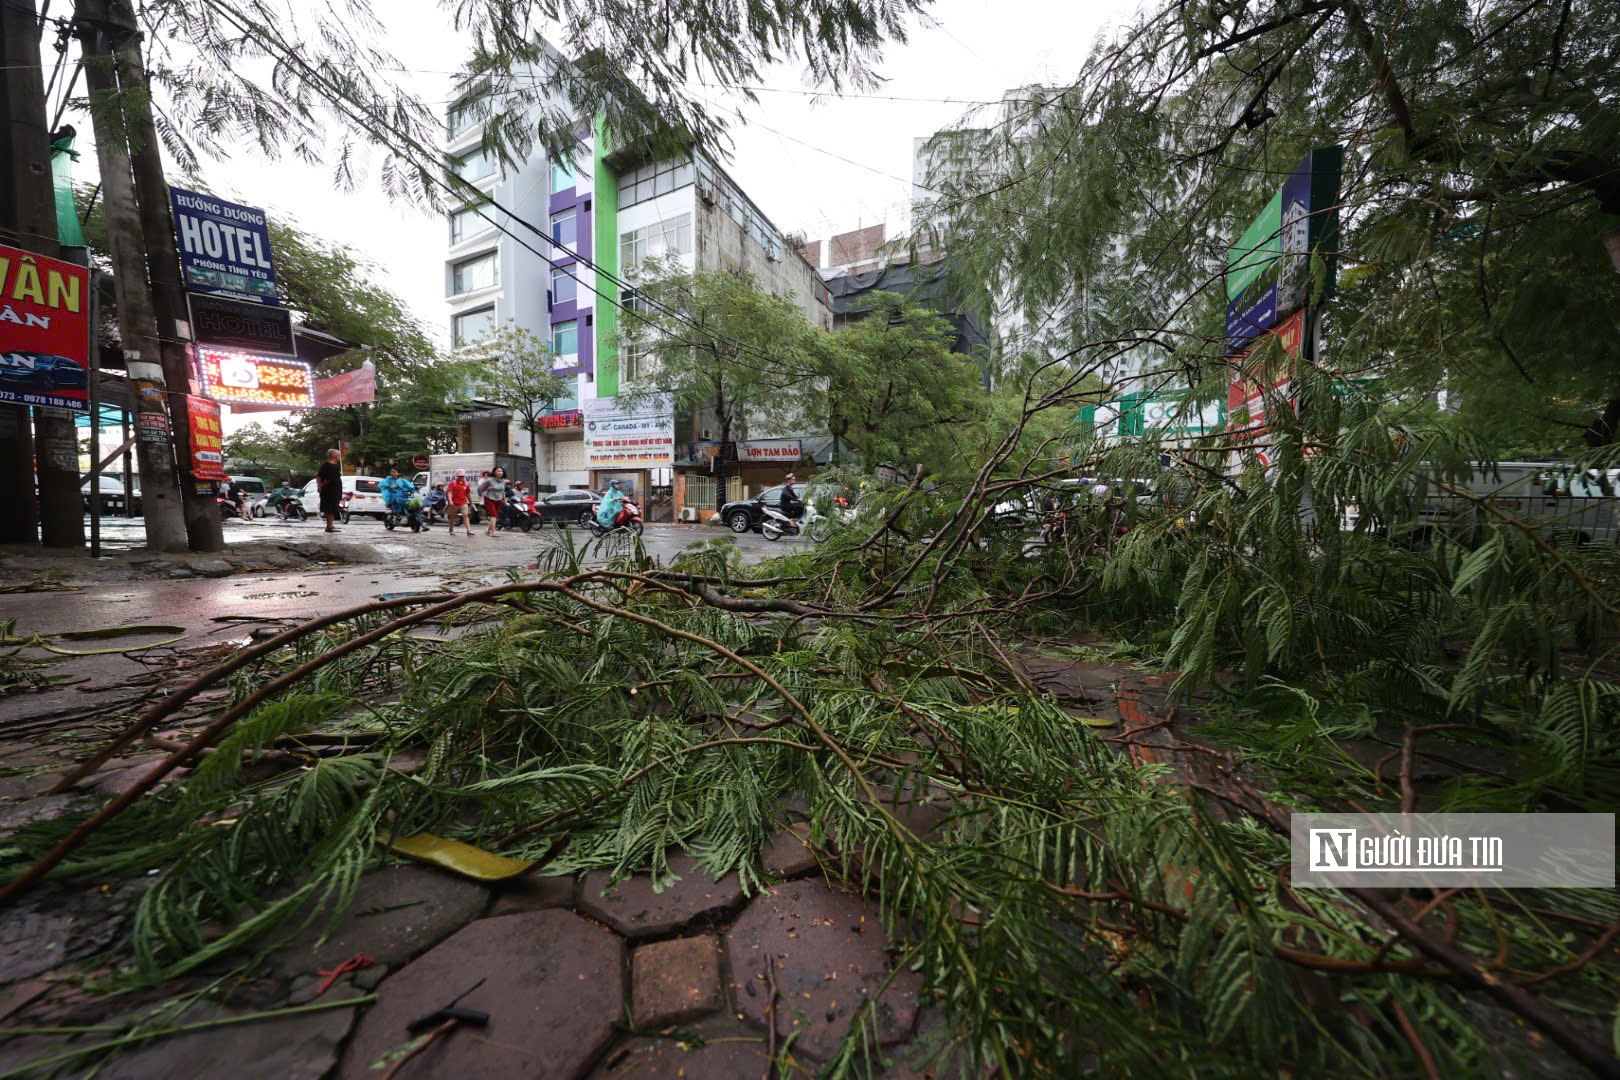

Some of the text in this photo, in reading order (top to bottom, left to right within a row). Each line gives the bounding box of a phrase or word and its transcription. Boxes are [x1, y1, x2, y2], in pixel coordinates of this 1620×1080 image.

[222, 206, 265, 226] DƯƠNG
[179, 213, 272, 269] HOTEL
[193, 258, 268, 279] PHÒNG TÌNH YÊU
[198, 310, 287, 341] HOTEL
[23, 393, 47, 404] 0978
[48, 397, 65, 406] 188
[613, 423, 638, 431] CANADA
[590, 454, 599, 464] DU
[600, 454, 612, 464] HỌC
[638, 451, 652, 462] VIỆT
[653, 452, 670, 462] NAM
[746, 444, 799, 458] LỢN TAM ĐẢO
